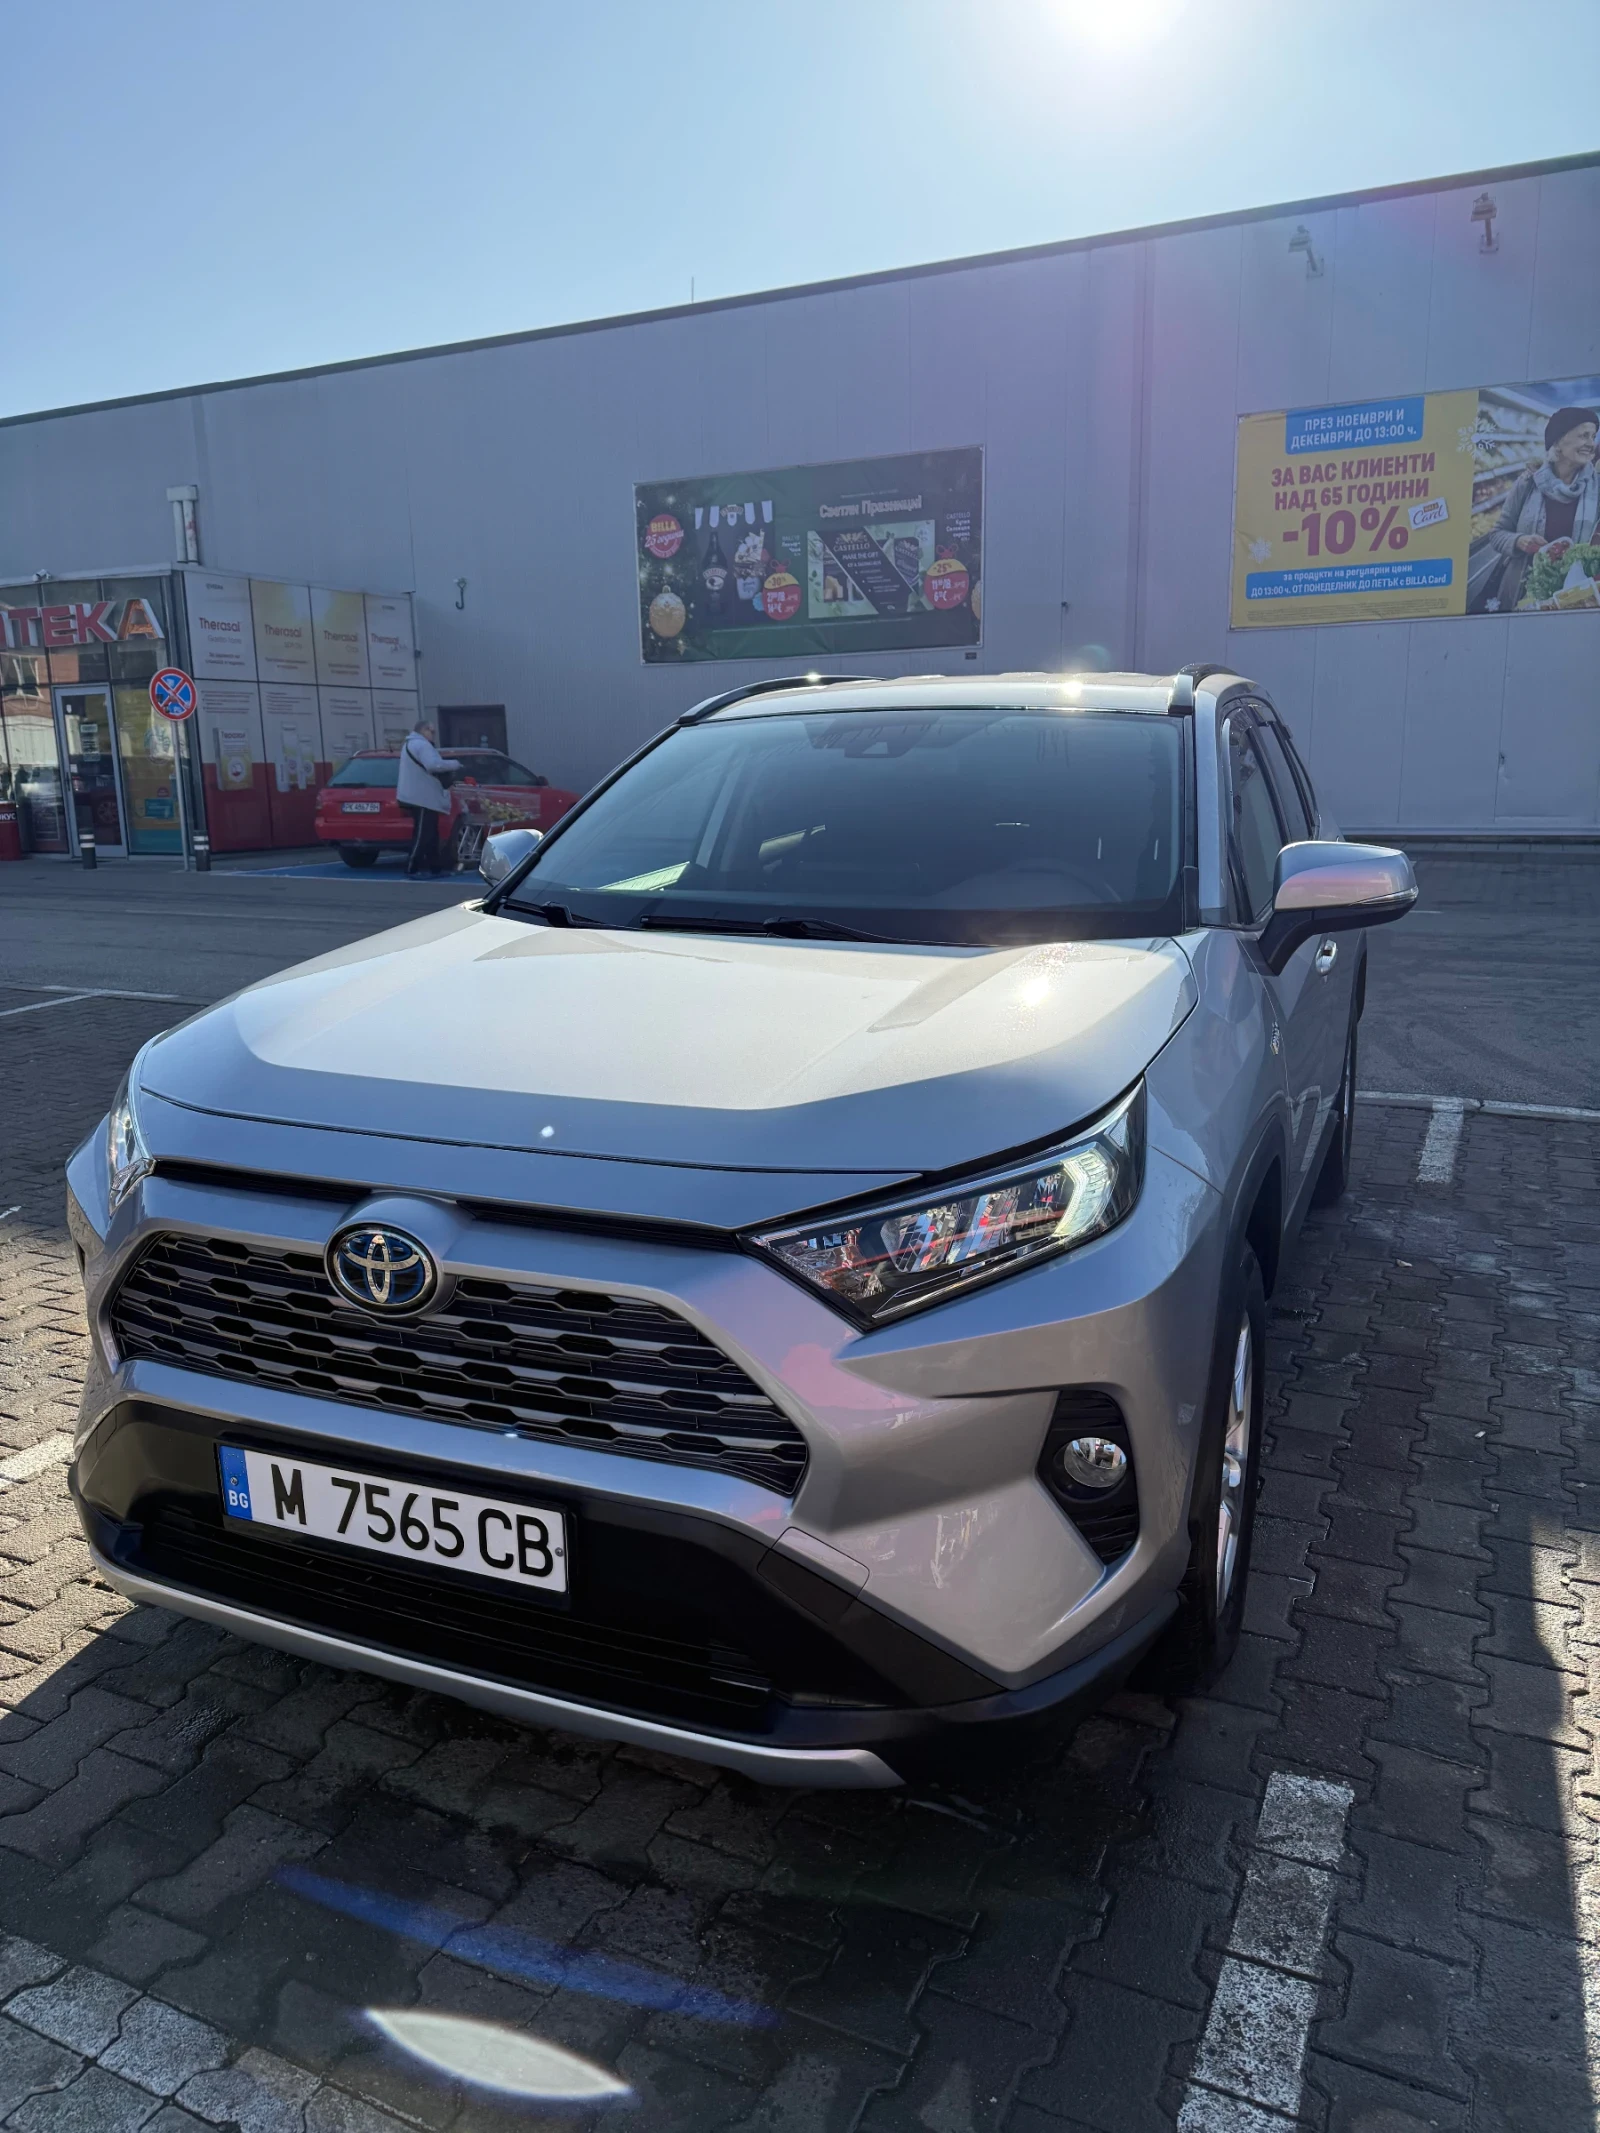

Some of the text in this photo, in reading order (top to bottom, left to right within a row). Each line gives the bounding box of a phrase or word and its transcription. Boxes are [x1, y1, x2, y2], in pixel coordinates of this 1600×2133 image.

[1305, 408, 1404, 432] ПРЕЗ НОЕМВРИ И
[1290, 430, 1352, 450] ДЕКЕМВРИ
[1354, 428, 1372, 443] ДО
[1374, 424, 1404, 438] 13:00
[1271, 452, 1436, 488] ЗА ВАС КЛИЕНТИ
[1275, 478, 1430, 512] НАД 65 ГОДИНИ
[650, 520, 677, 533] BILLA
[1413, 505, 1445, 526] Card
[644, 534, 657, 548] 25
[1282, 505, 1409, 557] -10%
[1283, 573, 1292, 581] за
[1294, 571, 1333, 583] продукти
[1334, 570, 1344, 578] на
[1346, 566, 1390, 580] регулярни
[1251, 587, 1263, 598] ДО
[1264, 585, 1284, 595] 13:00
[1292, 584, 1303, 593] ОТ
[1304, 581, 1357, 593] ПОНЕДЕЛНИК
[1358, 580, 1371, 590] ДО
[1372, 578, 1398, 589] ПЕТЪК
[1406, 577, 1427, 586] BILLA
[1428, 575, 1446, 584] Card
[0, 599, 165, 648] ТЕКА
[199, 617, 241, 632] Therasal
[228, 1490, 249, 1509] BG
[271, 1463, 554, 1578] M 7565 CB
